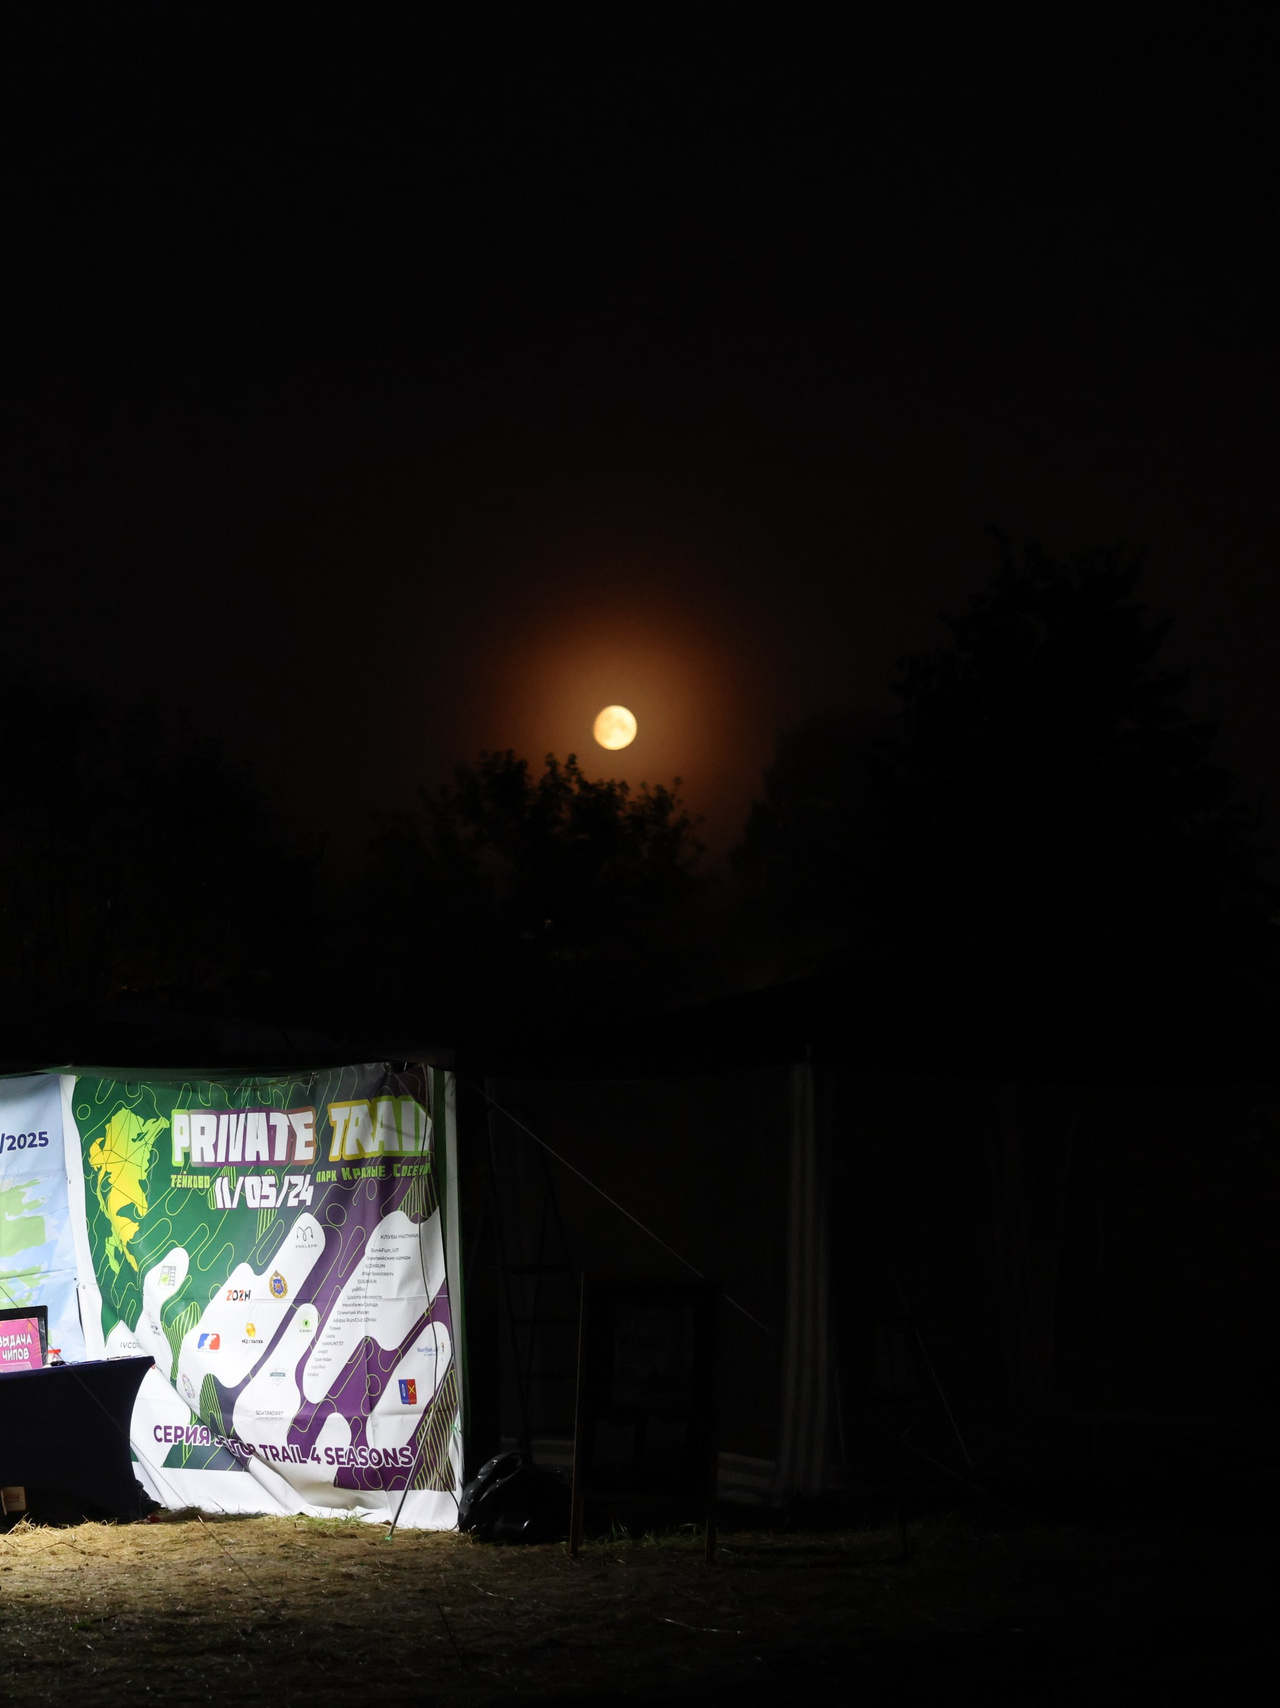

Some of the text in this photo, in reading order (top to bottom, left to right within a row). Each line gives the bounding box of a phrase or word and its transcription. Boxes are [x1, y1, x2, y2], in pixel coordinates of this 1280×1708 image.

[172, 1109, 315, 1164] PRIVATE
[171, 1170, 210, 1188] ТЕЙКОВО
[316, 1170, 337, 1183] ПАРК
[215, 1174, 314, 1209] 11/05/24
[226, 1290, 251, 1302] ZOZH
[2, 1348, 30, 1362] ЧИПОВ
[154, 1425, 210, 1445] СЕРИЯ
[259, 1444, 308, 1464] TRAIL
[311, 1446, 321, 1465] 4
[324, 1446, 414, 1468] SEASONS
